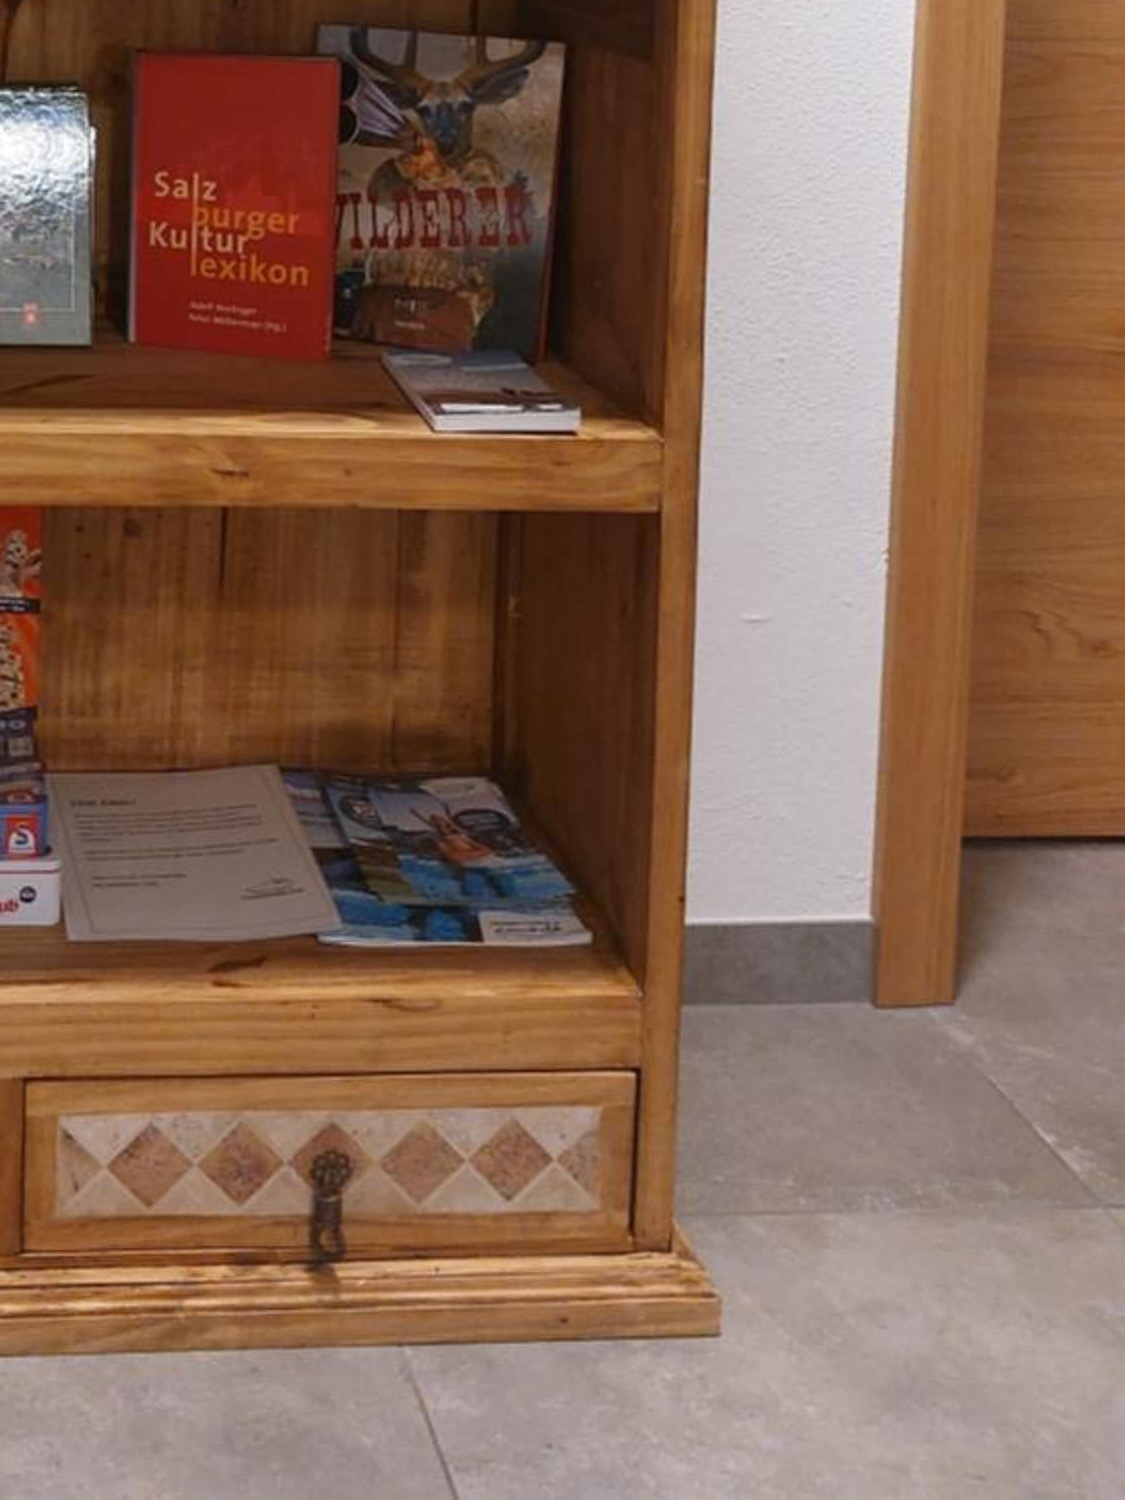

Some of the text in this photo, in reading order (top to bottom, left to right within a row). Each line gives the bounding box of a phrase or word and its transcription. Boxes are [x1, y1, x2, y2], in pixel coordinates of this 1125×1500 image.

[154, 171, 219, 202] Salz
[149, 220, 249, 254] Kultur
[191, 205, 300, 241] burger
[191, 253, 310, 287] lexikon
